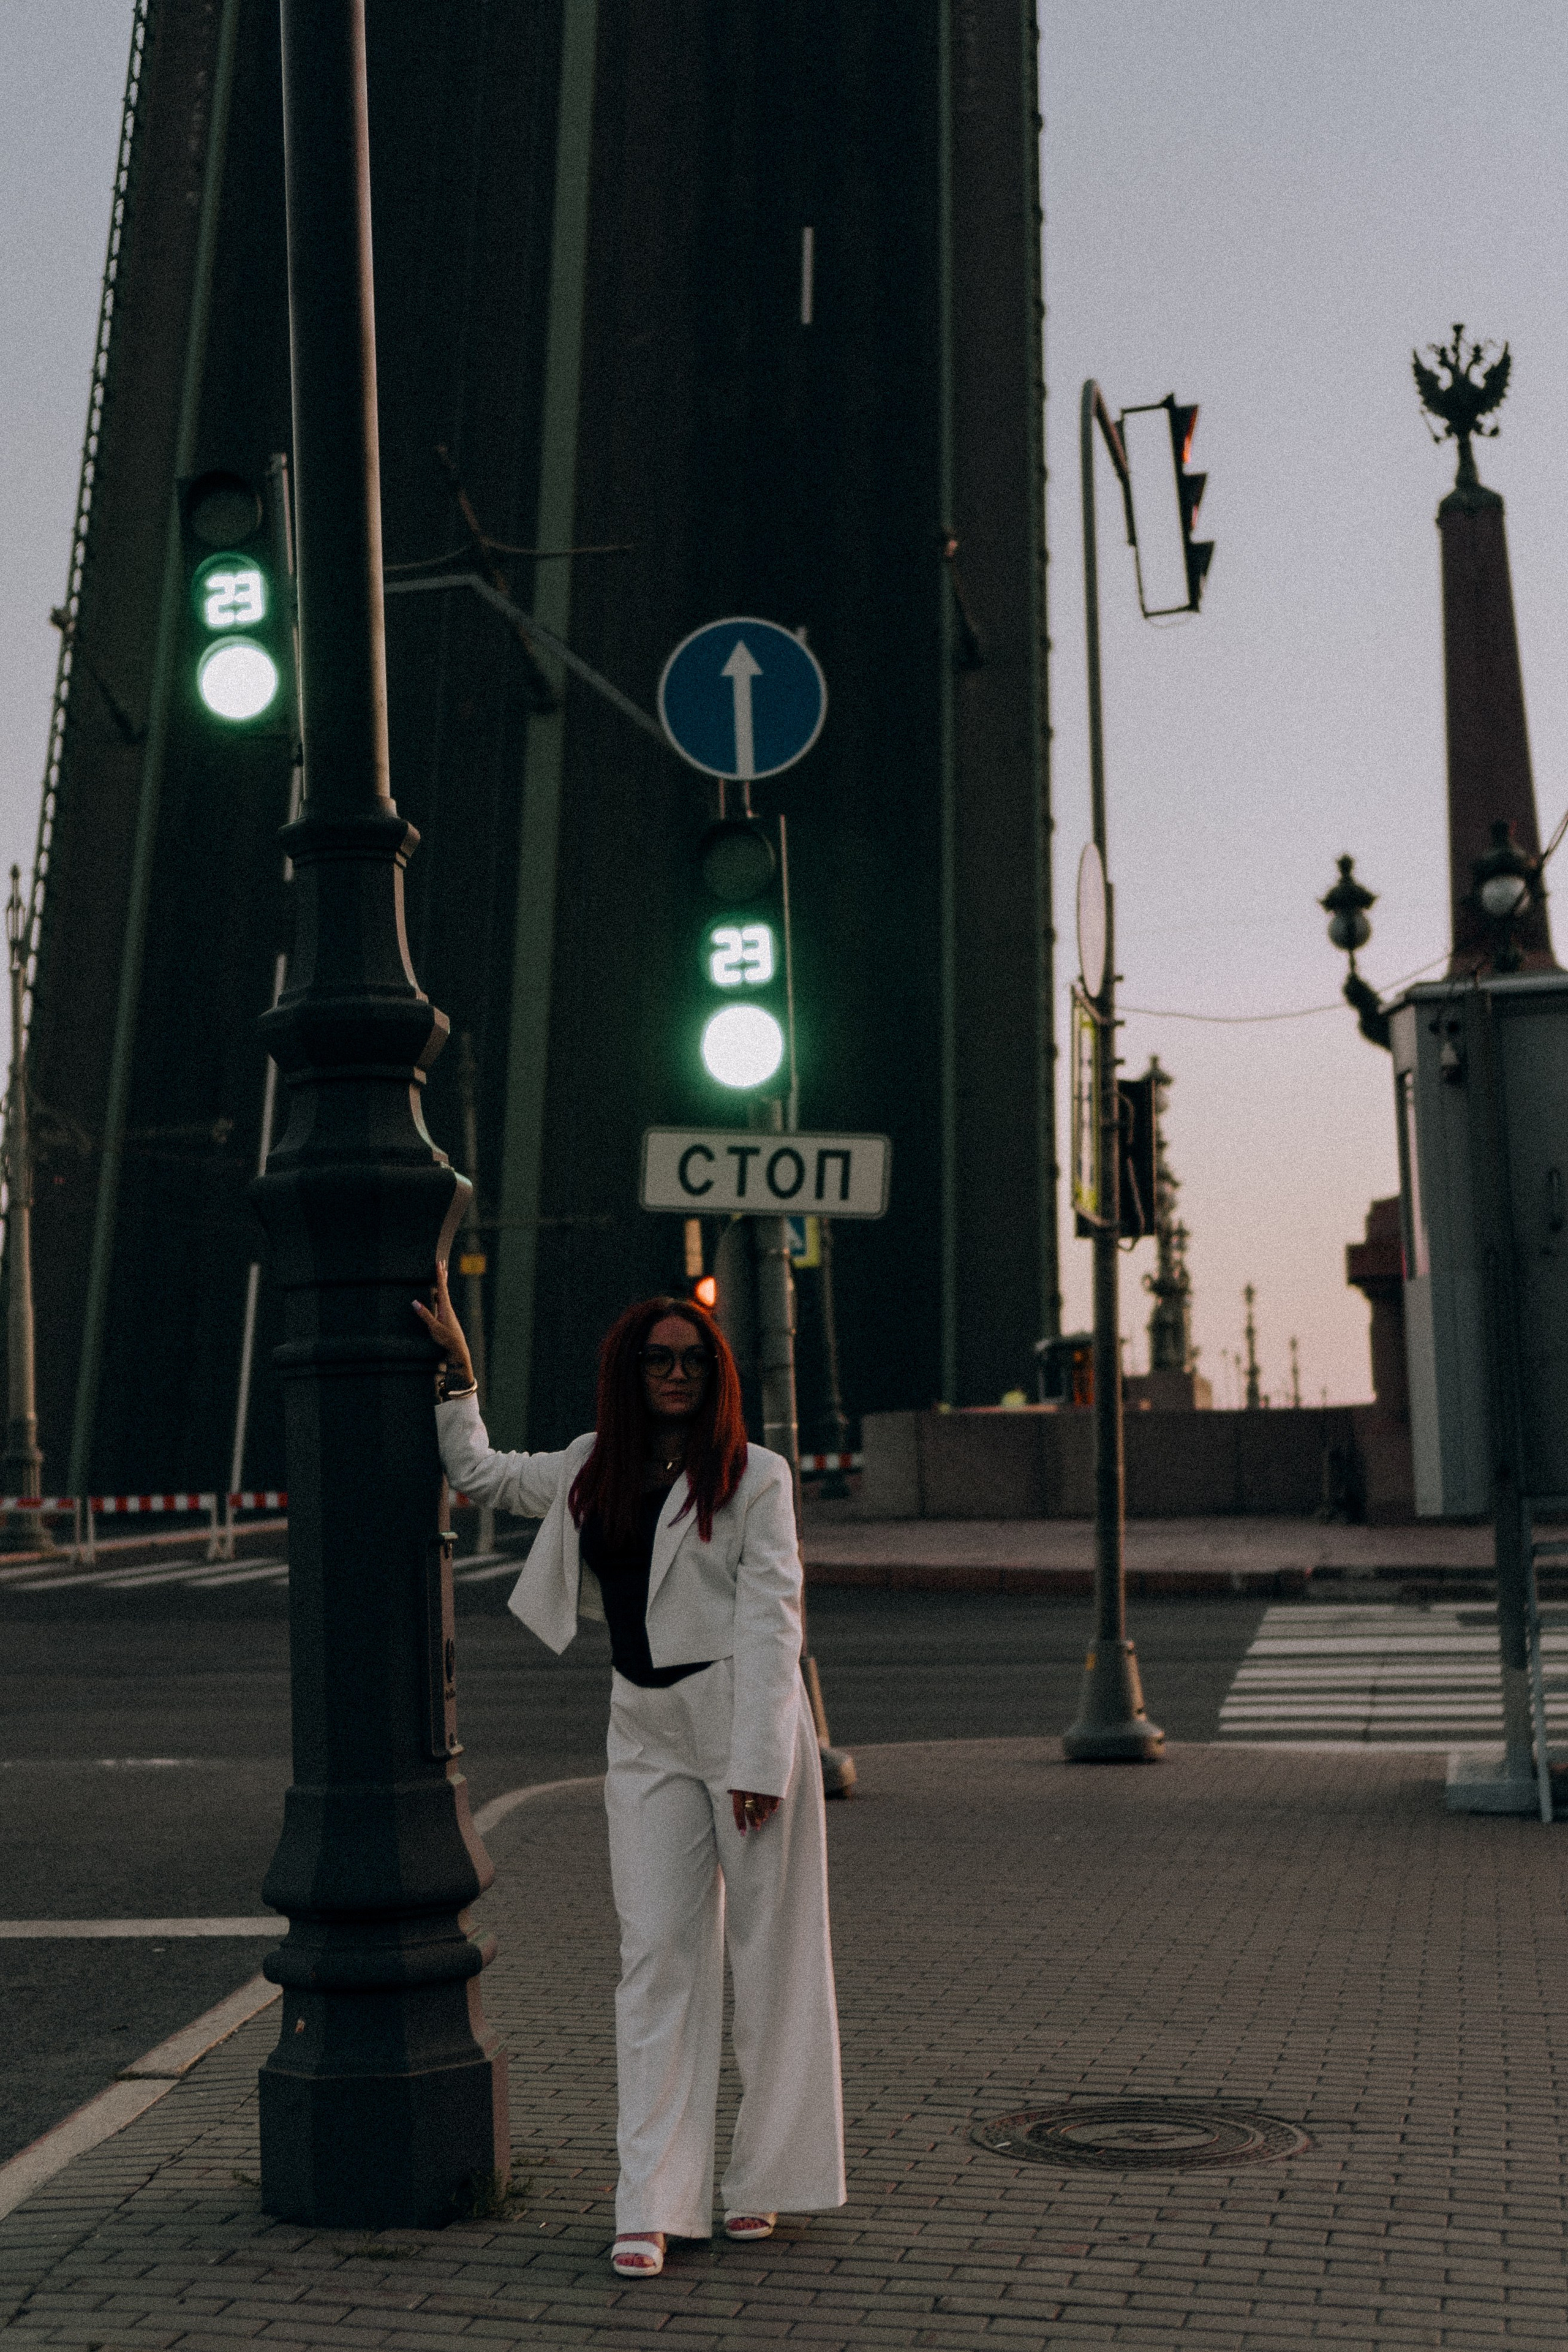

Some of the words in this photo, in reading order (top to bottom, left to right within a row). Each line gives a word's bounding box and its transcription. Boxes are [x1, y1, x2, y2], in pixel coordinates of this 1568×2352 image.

[205, 570, 265, 627] 23
[710, 924, 774, 987] 23
[677, 1144, 851, 1200] СТОП
